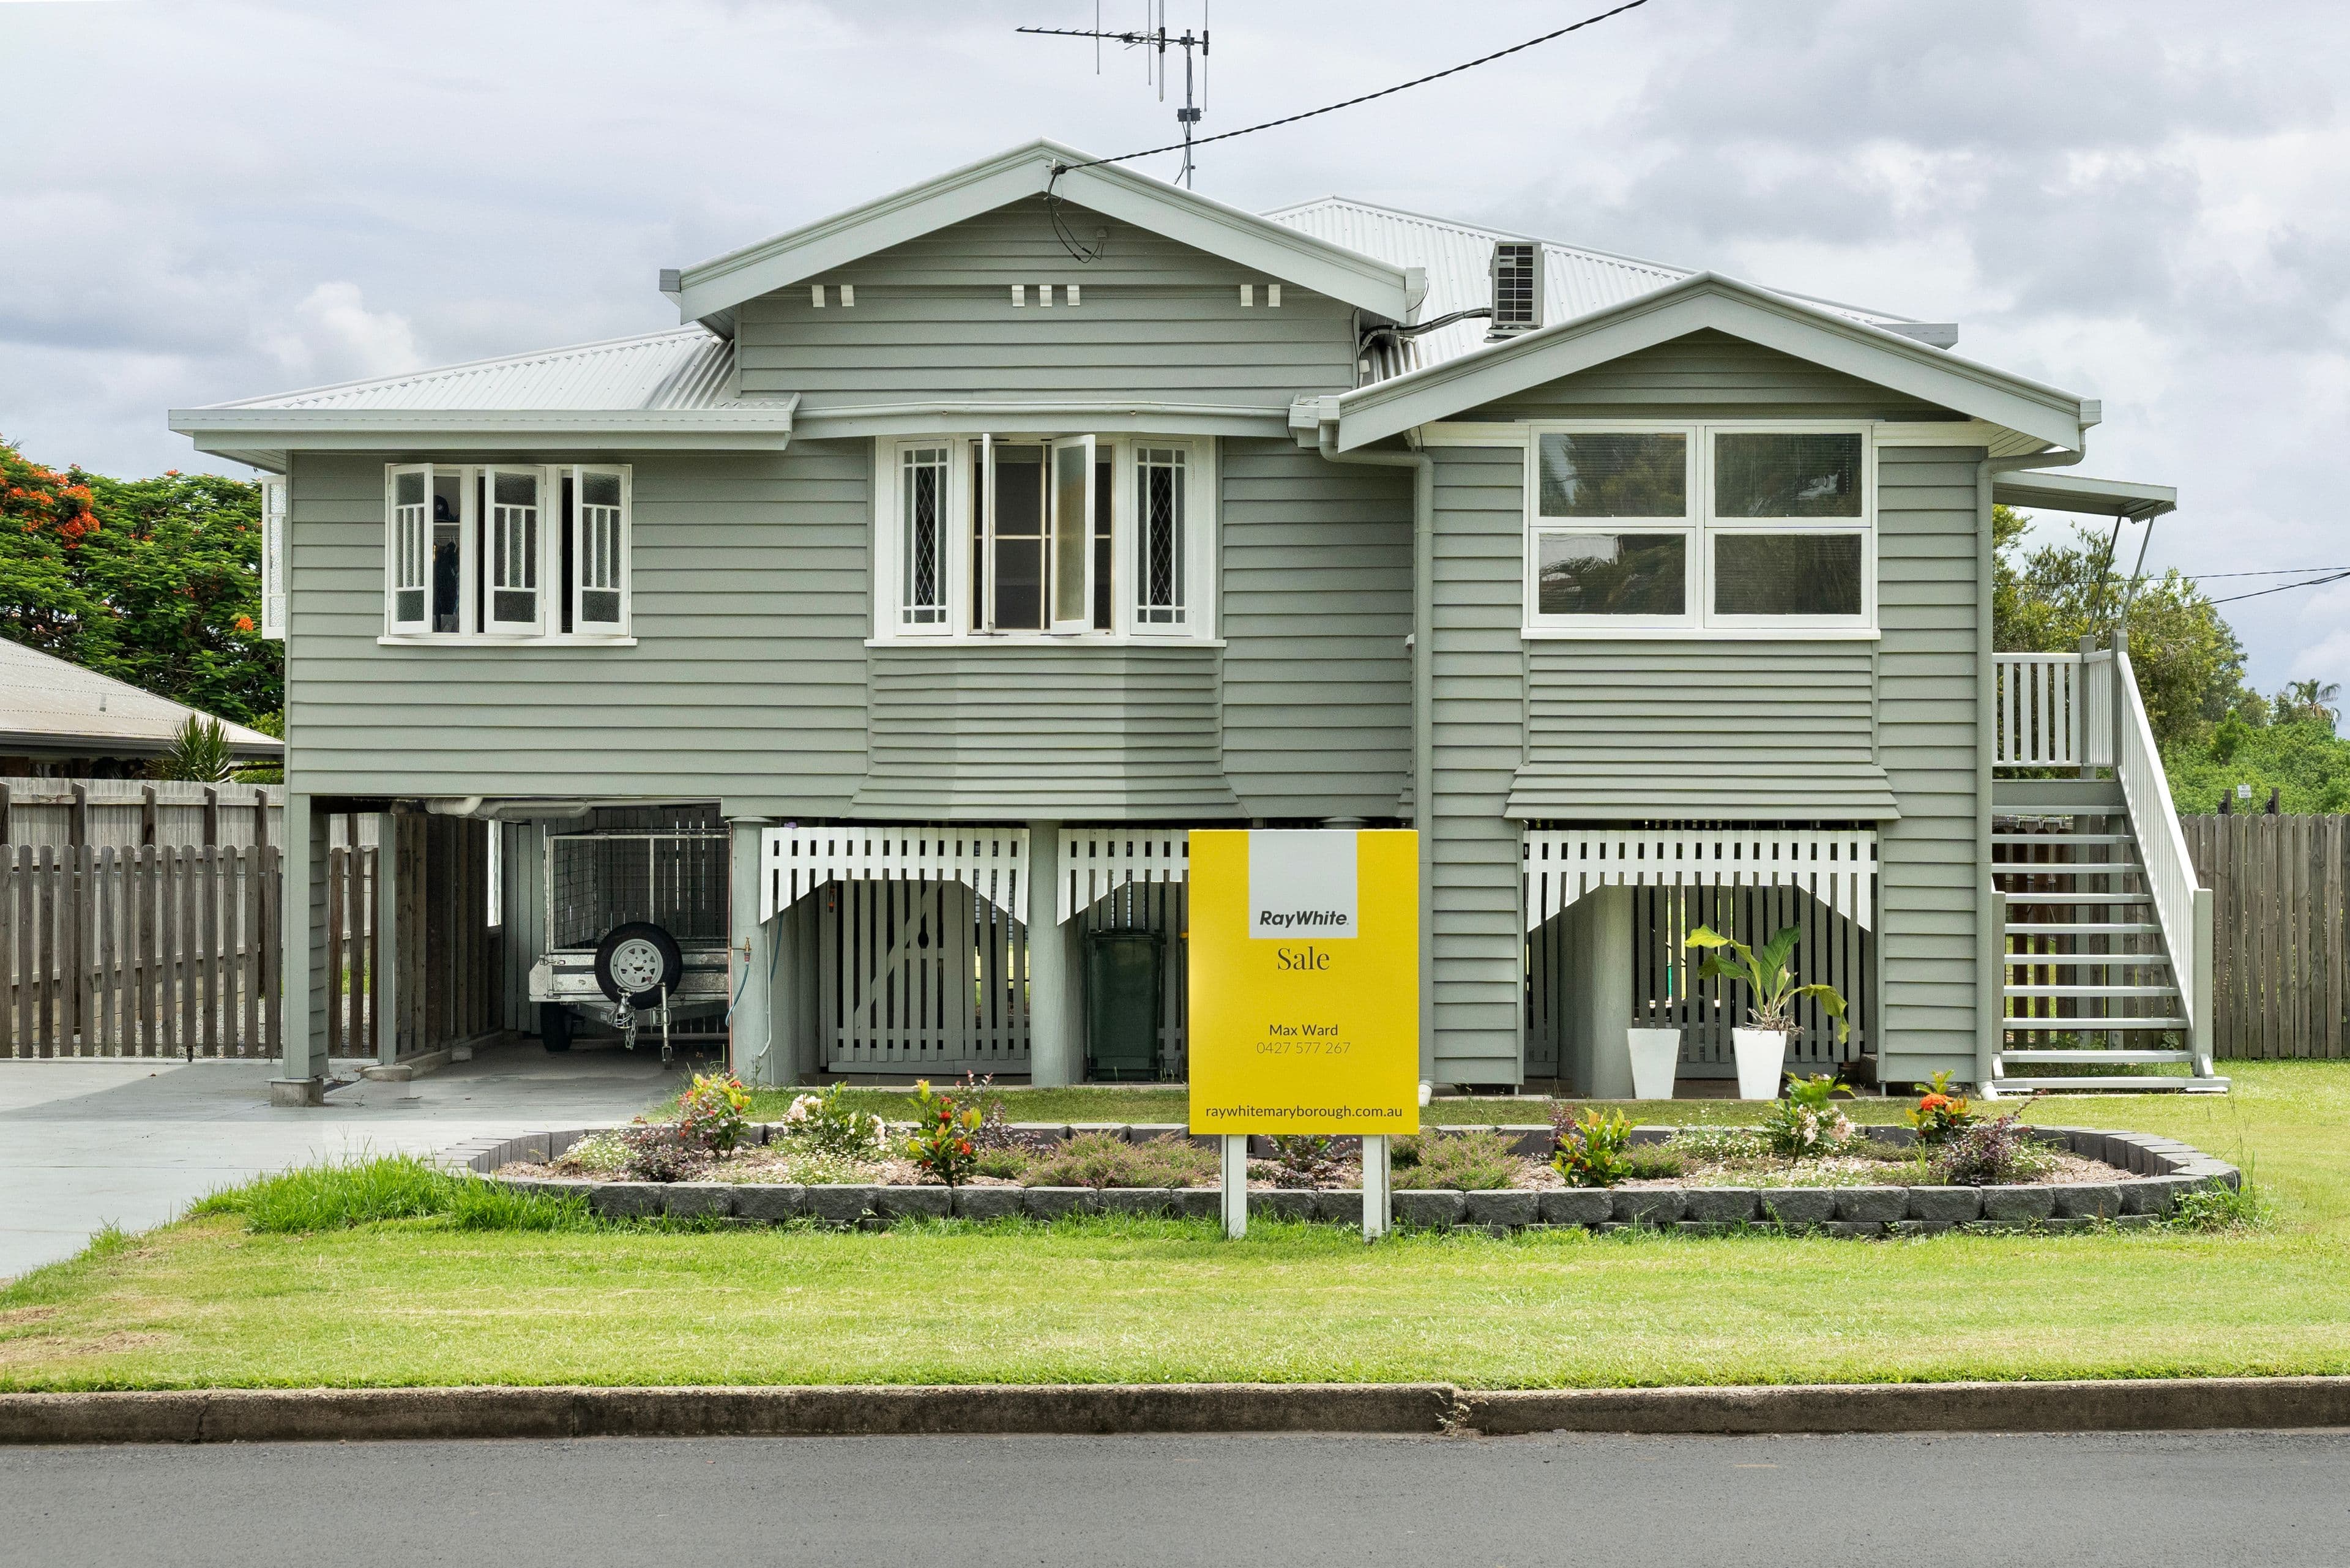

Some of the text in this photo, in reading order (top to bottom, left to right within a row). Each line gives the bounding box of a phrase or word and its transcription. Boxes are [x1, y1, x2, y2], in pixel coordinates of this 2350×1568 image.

[1277, 946, 1330, 971] Sale
[1269, 1024, 1338, 1036] Max Ward
[1256, 1042, 1351, 1054] 0427 577 267
[1206, 1105, 1403, 1119] raywhitemaryborough.com.au
